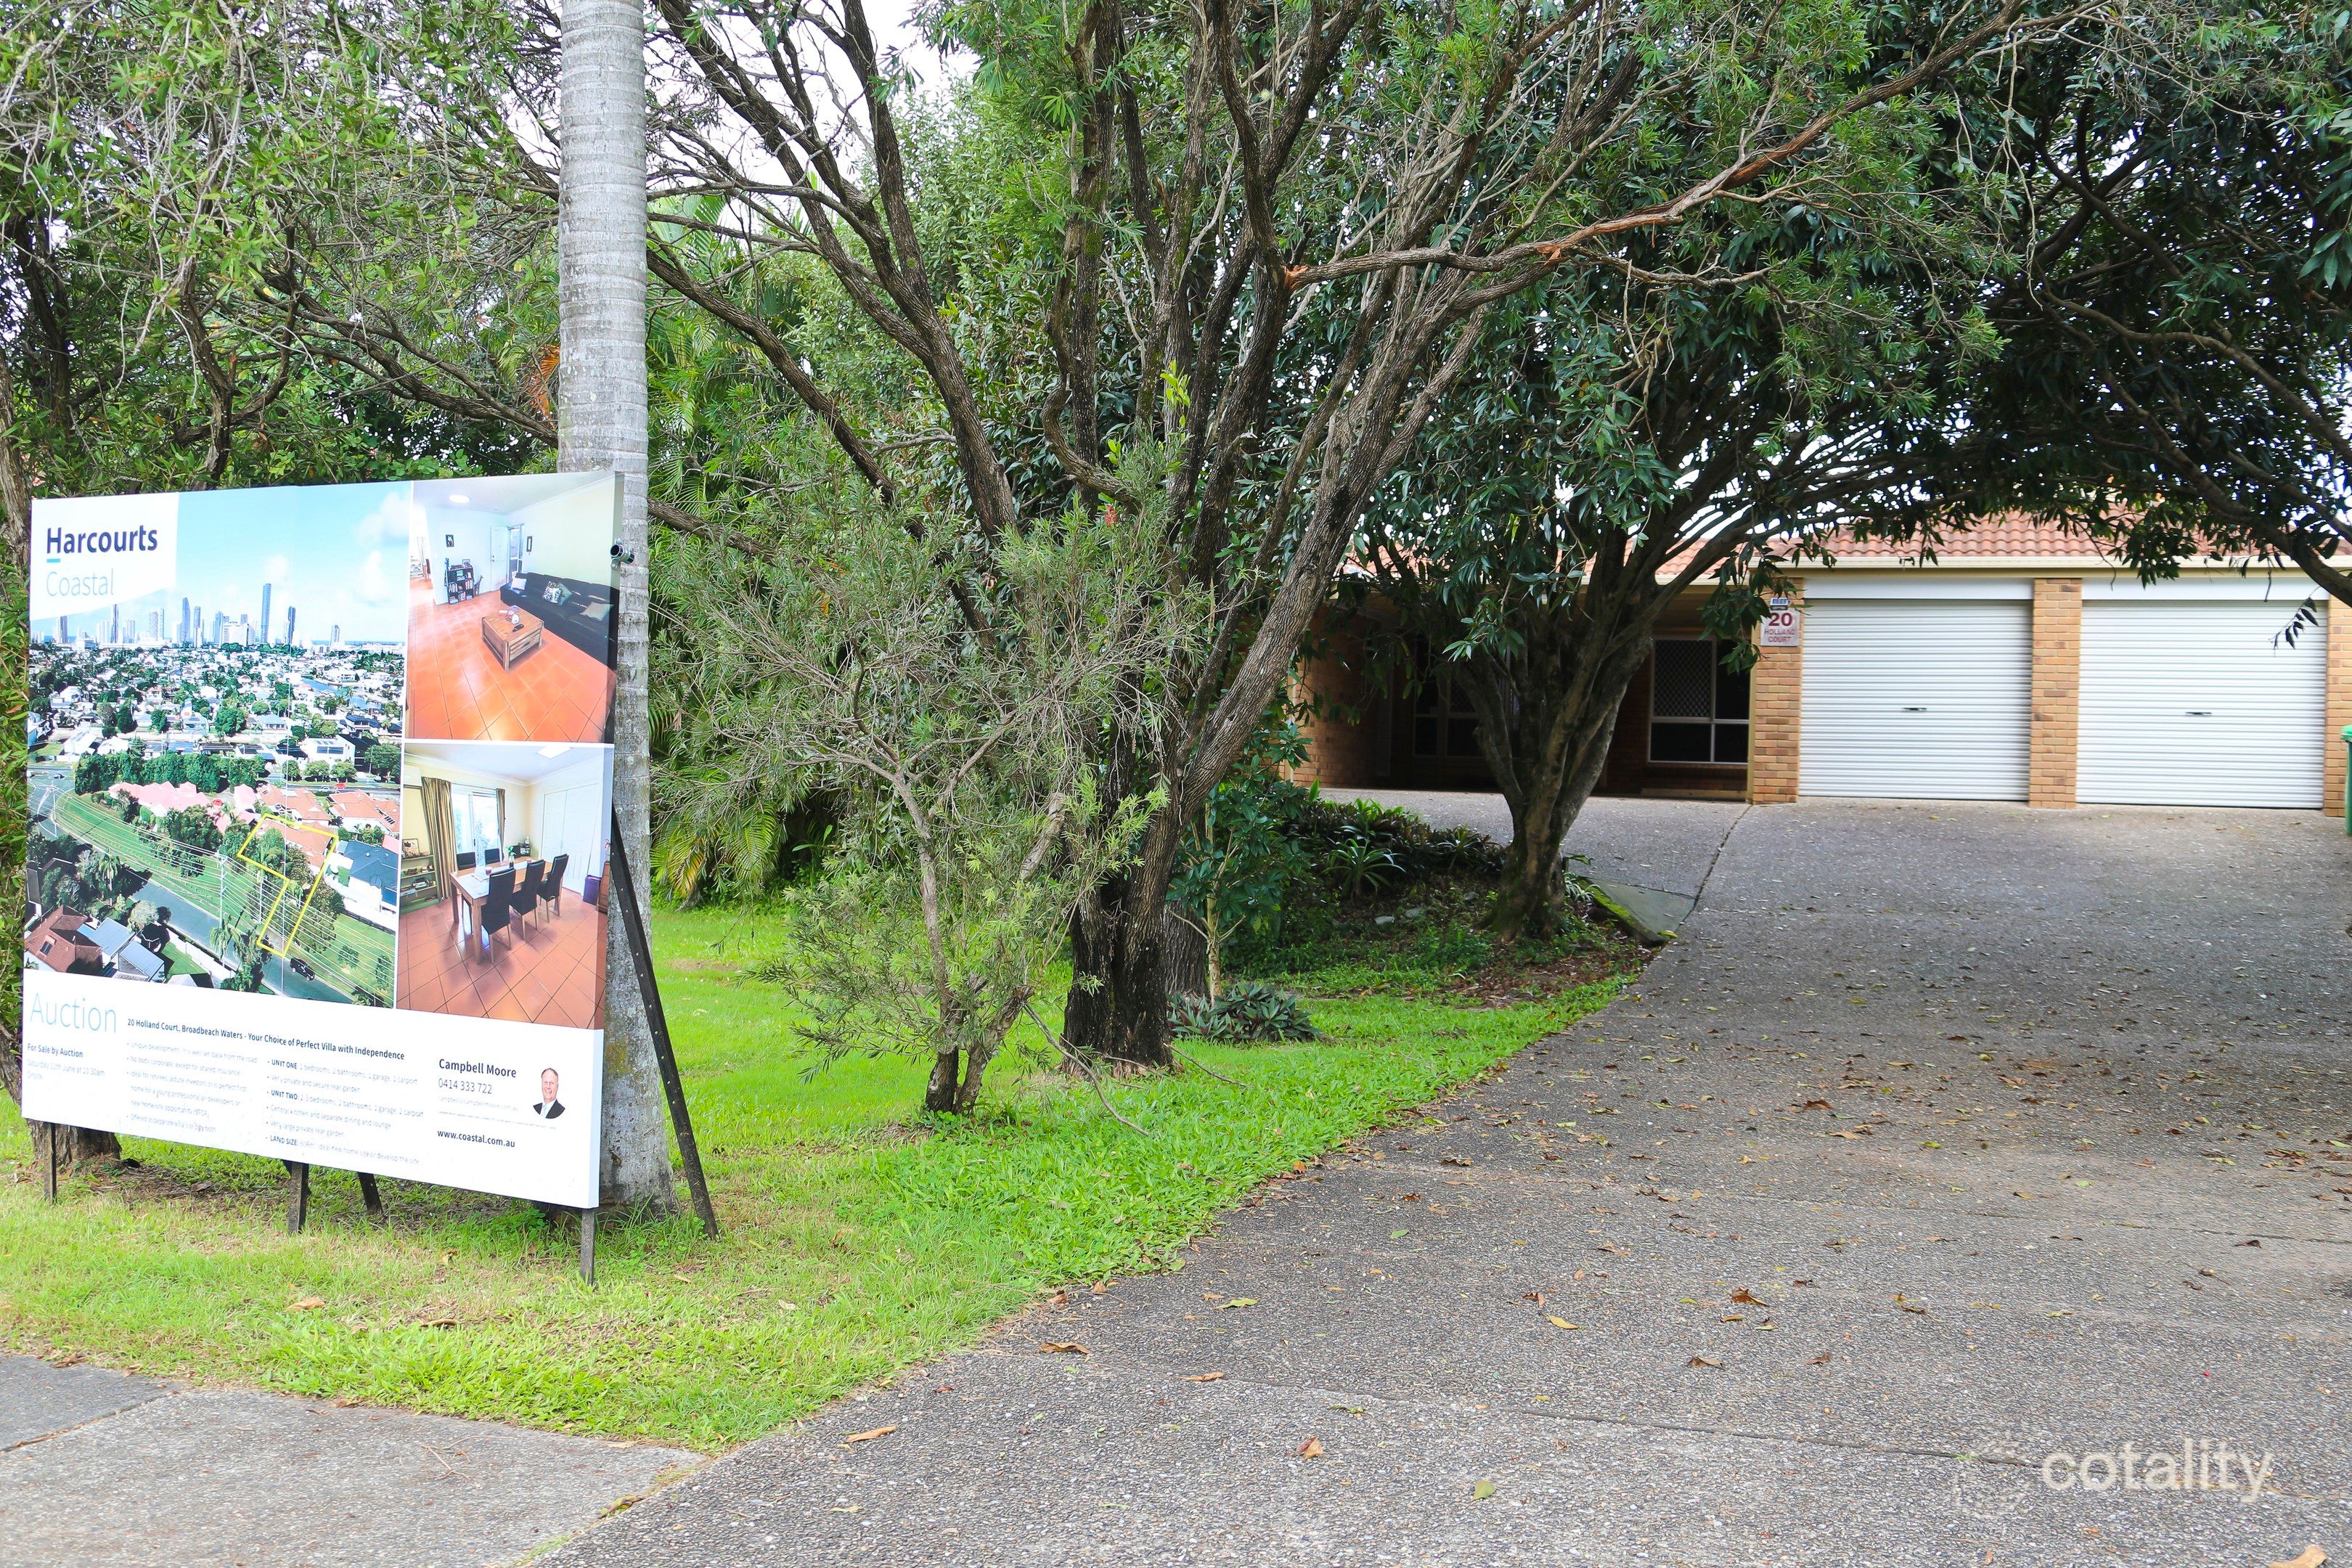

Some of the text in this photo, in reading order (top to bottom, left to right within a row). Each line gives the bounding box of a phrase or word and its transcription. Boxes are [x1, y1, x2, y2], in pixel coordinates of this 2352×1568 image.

[46, 525, 158, 554] Harcourts
[46, 568, 114, 596] Coastal
[1769, 613, 1792, 626] 20
[30, 993, 116, 1033] Auction
[136, 1020, 159, 1029] Holland
[161, 1022, 180, 1032] Court,
[182, 1025, 219, 1036] Broadbeach
[221, 1030, 243, 1039] Waters
[248, 1033, 263, 1042] Your
[264, 1035, 286, 1045] Choice
[296, 1040, 319, 1050] Perfect
[321, 1042, 336, 1051] Villa
[338, 1045, 353, 1054] with
[355, 1047, 405, 1060] Independence
[38, 1045, 50, 1053] Sale
[52, 1047, 58, 1056] by
[60, 1048, 83, 1057] Auction
[272, 1059, 285, 1067] UNIT
[439, 1059, 517, 1078] Campbell Moore
[438, 1078, 492, 1094] 0414 333 722
[270, 1135, 285, 1143] LAND
[437, 1130, 515, 1147] www.coastal.com.au
